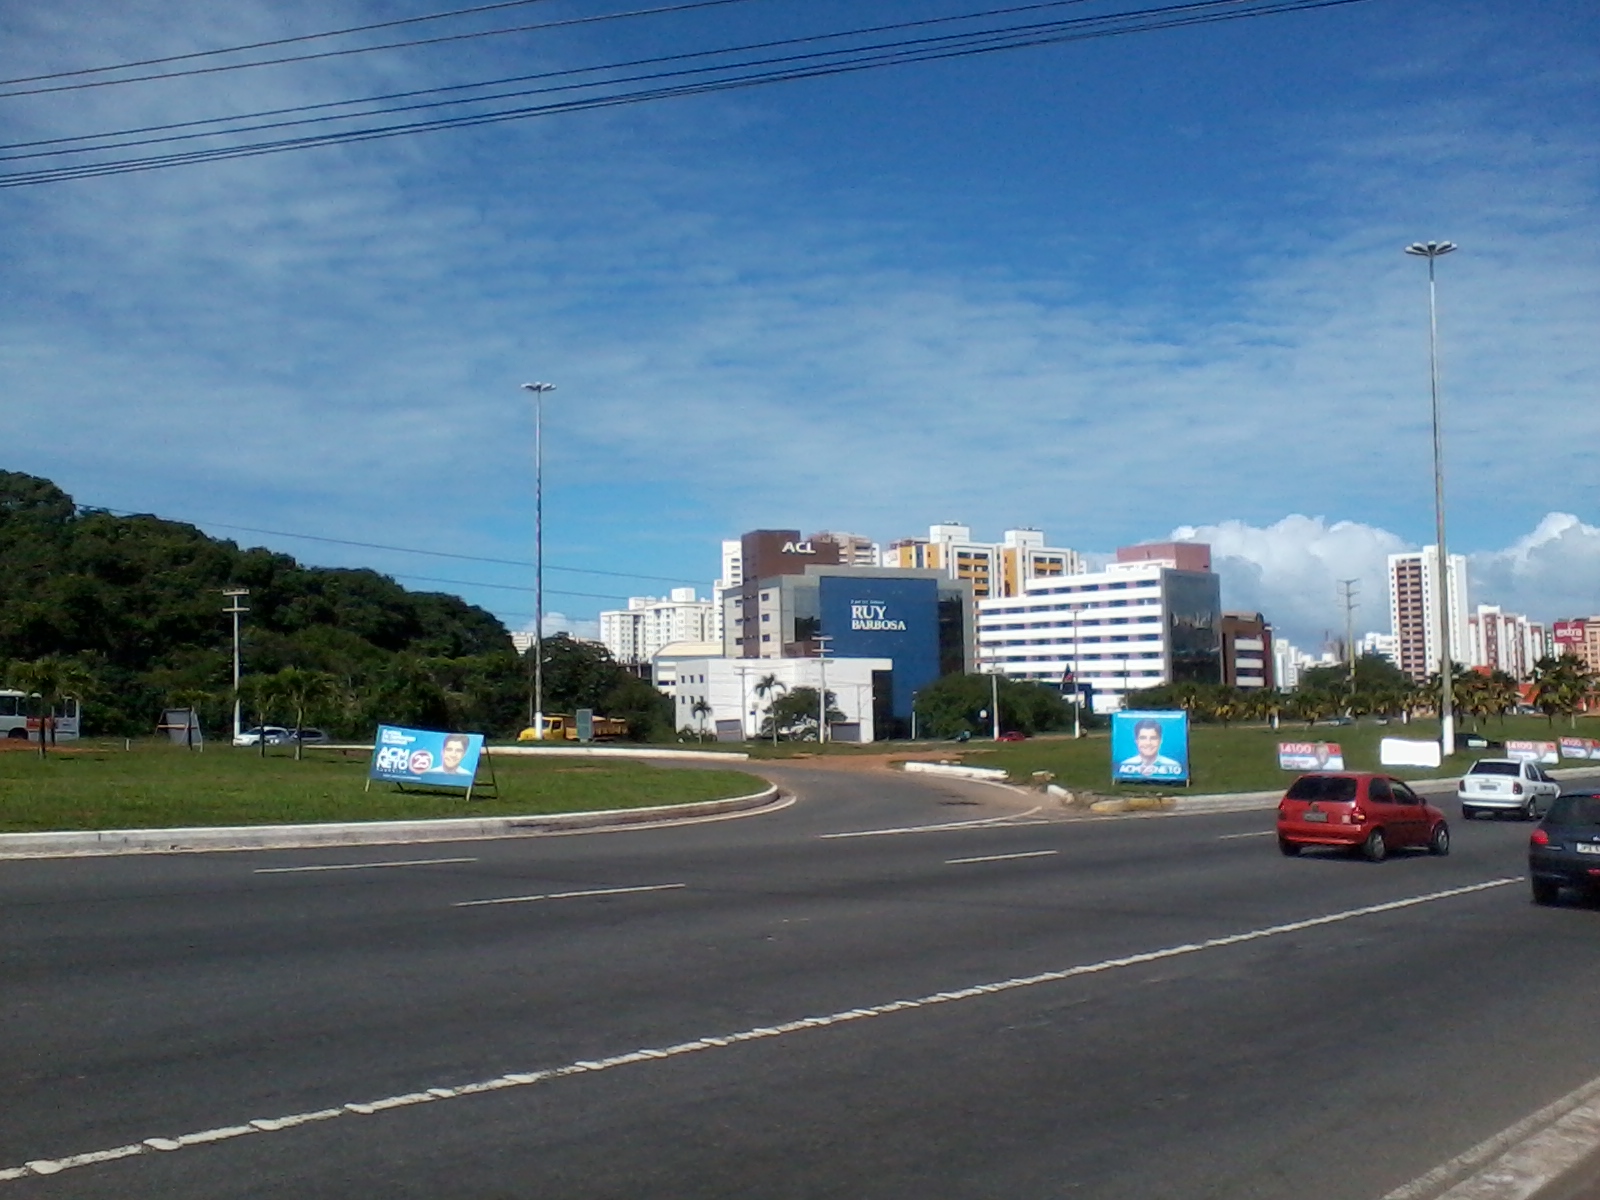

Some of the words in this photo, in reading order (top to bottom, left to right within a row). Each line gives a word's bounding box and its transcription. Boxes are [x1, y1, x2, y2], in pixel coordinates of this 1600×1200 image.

[781, 541, 817, 554] ACL
[851, 605, 887, 620] RUY
[851, 619, 907, 631] BARBOSA
[1556, 628, 1582, 637] extra
[412, 754, 431, 769] 25
